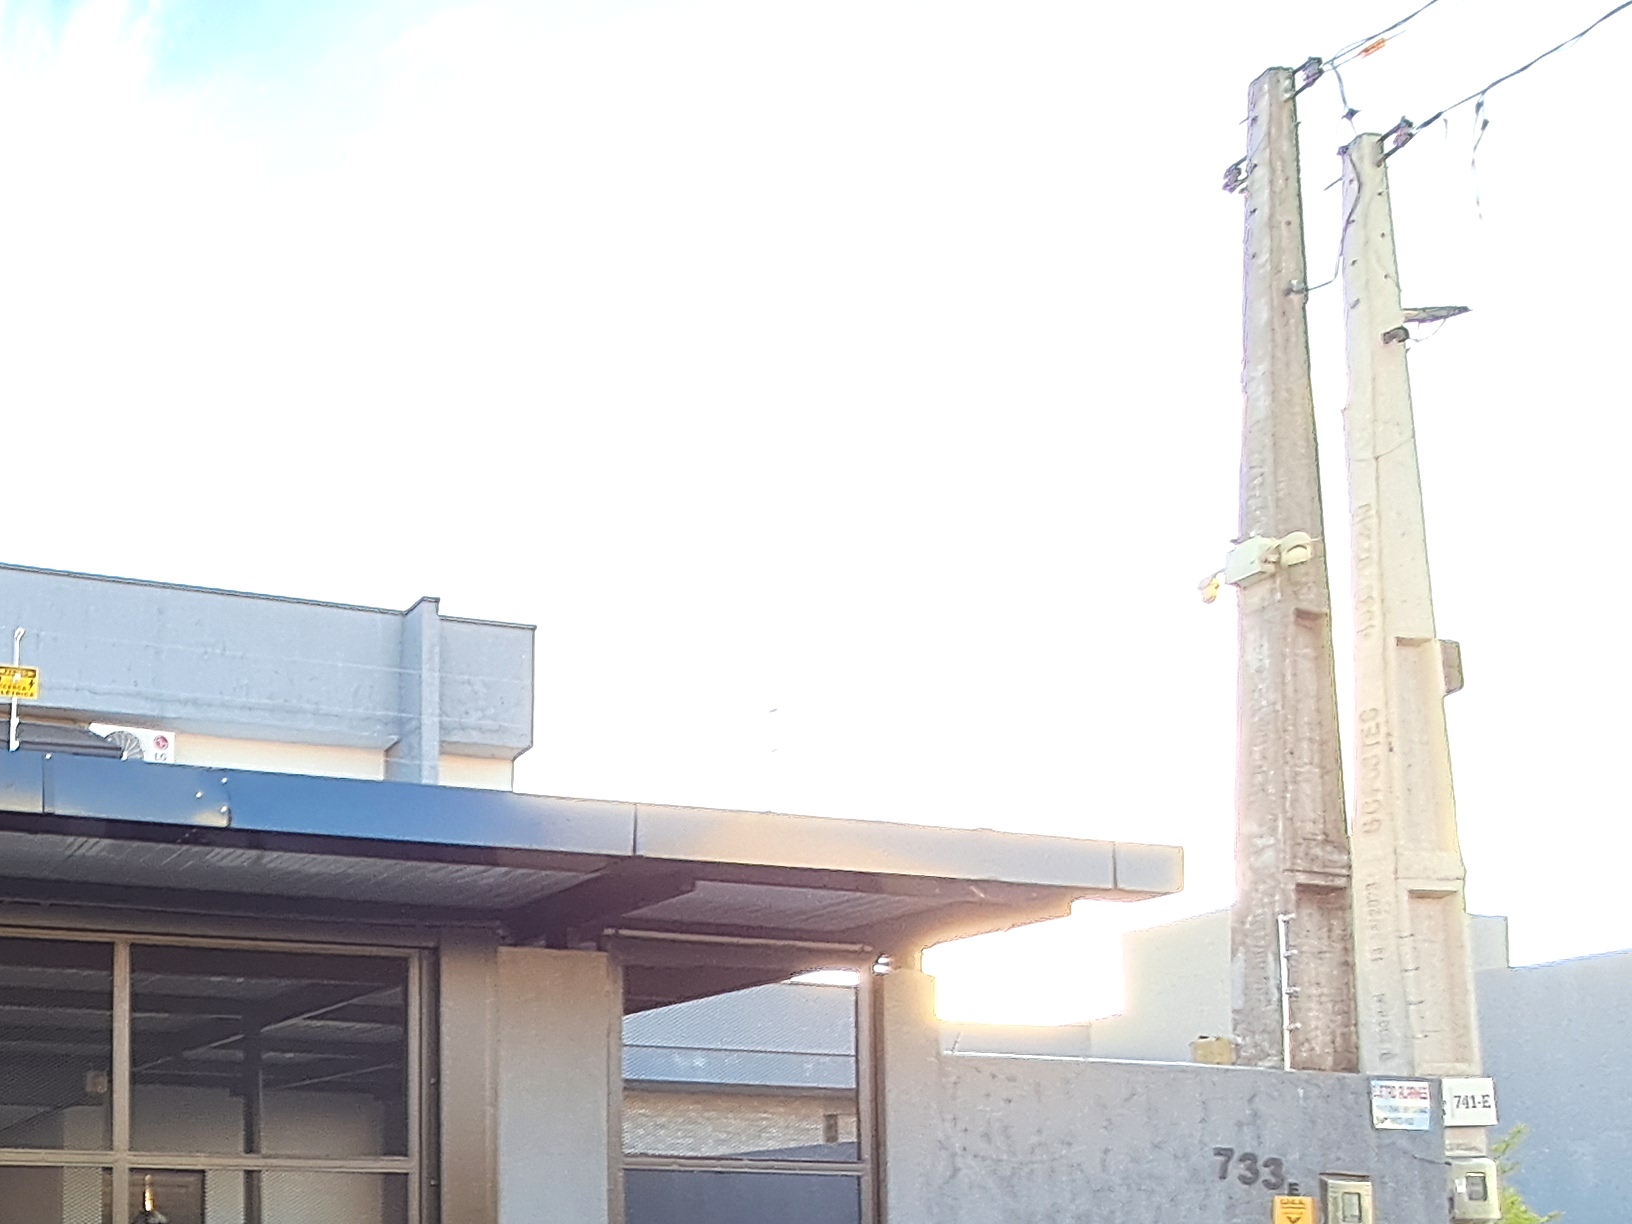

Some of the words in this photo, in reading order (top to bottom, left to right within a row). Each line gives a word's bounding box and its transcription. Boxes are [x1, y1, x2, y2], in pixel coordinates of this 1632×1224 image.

[1453, 1094, 1492, 1109] 741-E
[1212, 1147, 1285, 1190] 733
[1288, 1182, 1299, 1196] E
